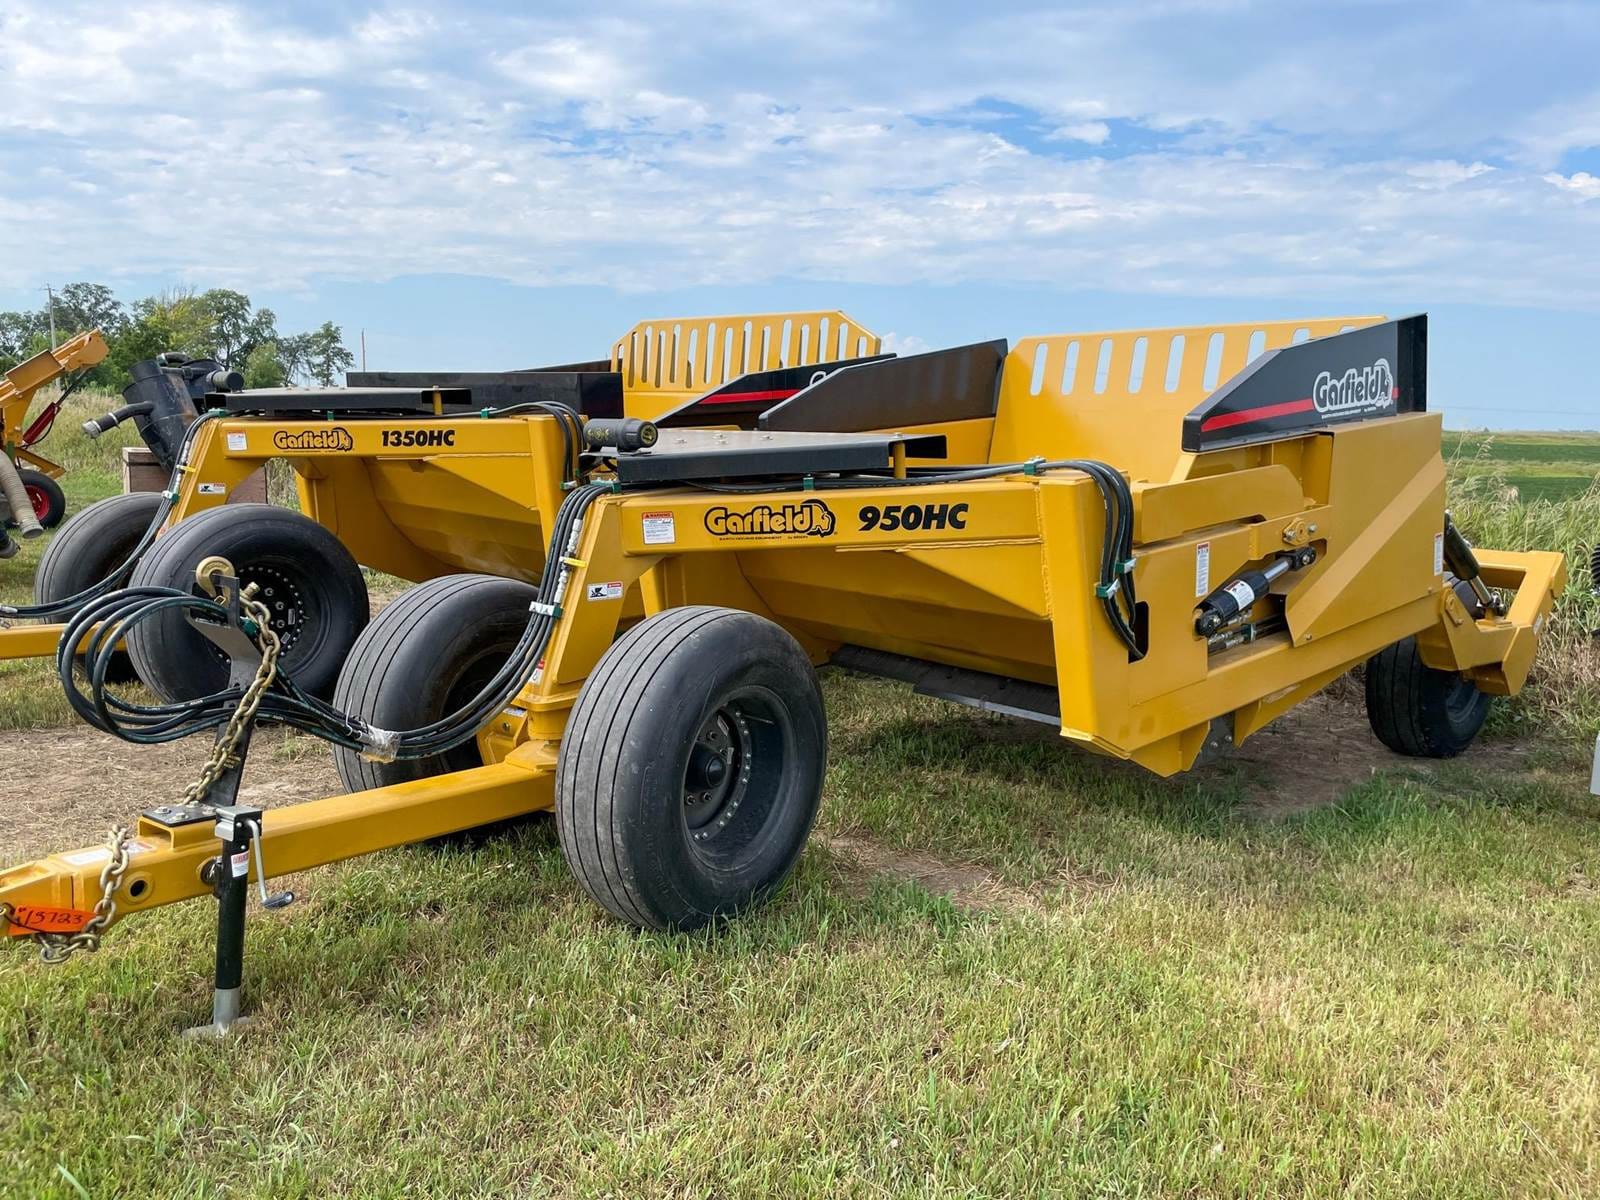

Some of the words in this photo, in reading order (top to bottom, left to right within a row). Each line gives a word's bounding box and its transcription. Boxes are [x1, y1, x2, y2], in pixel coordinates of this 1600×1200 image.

[1312, 363, 1384, 412] Garfield
[273, 430, 343, 450] Garfield
[382, 429, 455, 447] 1350HC
[704, 504, 816, 536] Garfield
[857, 503, 969, 532] 950HC
